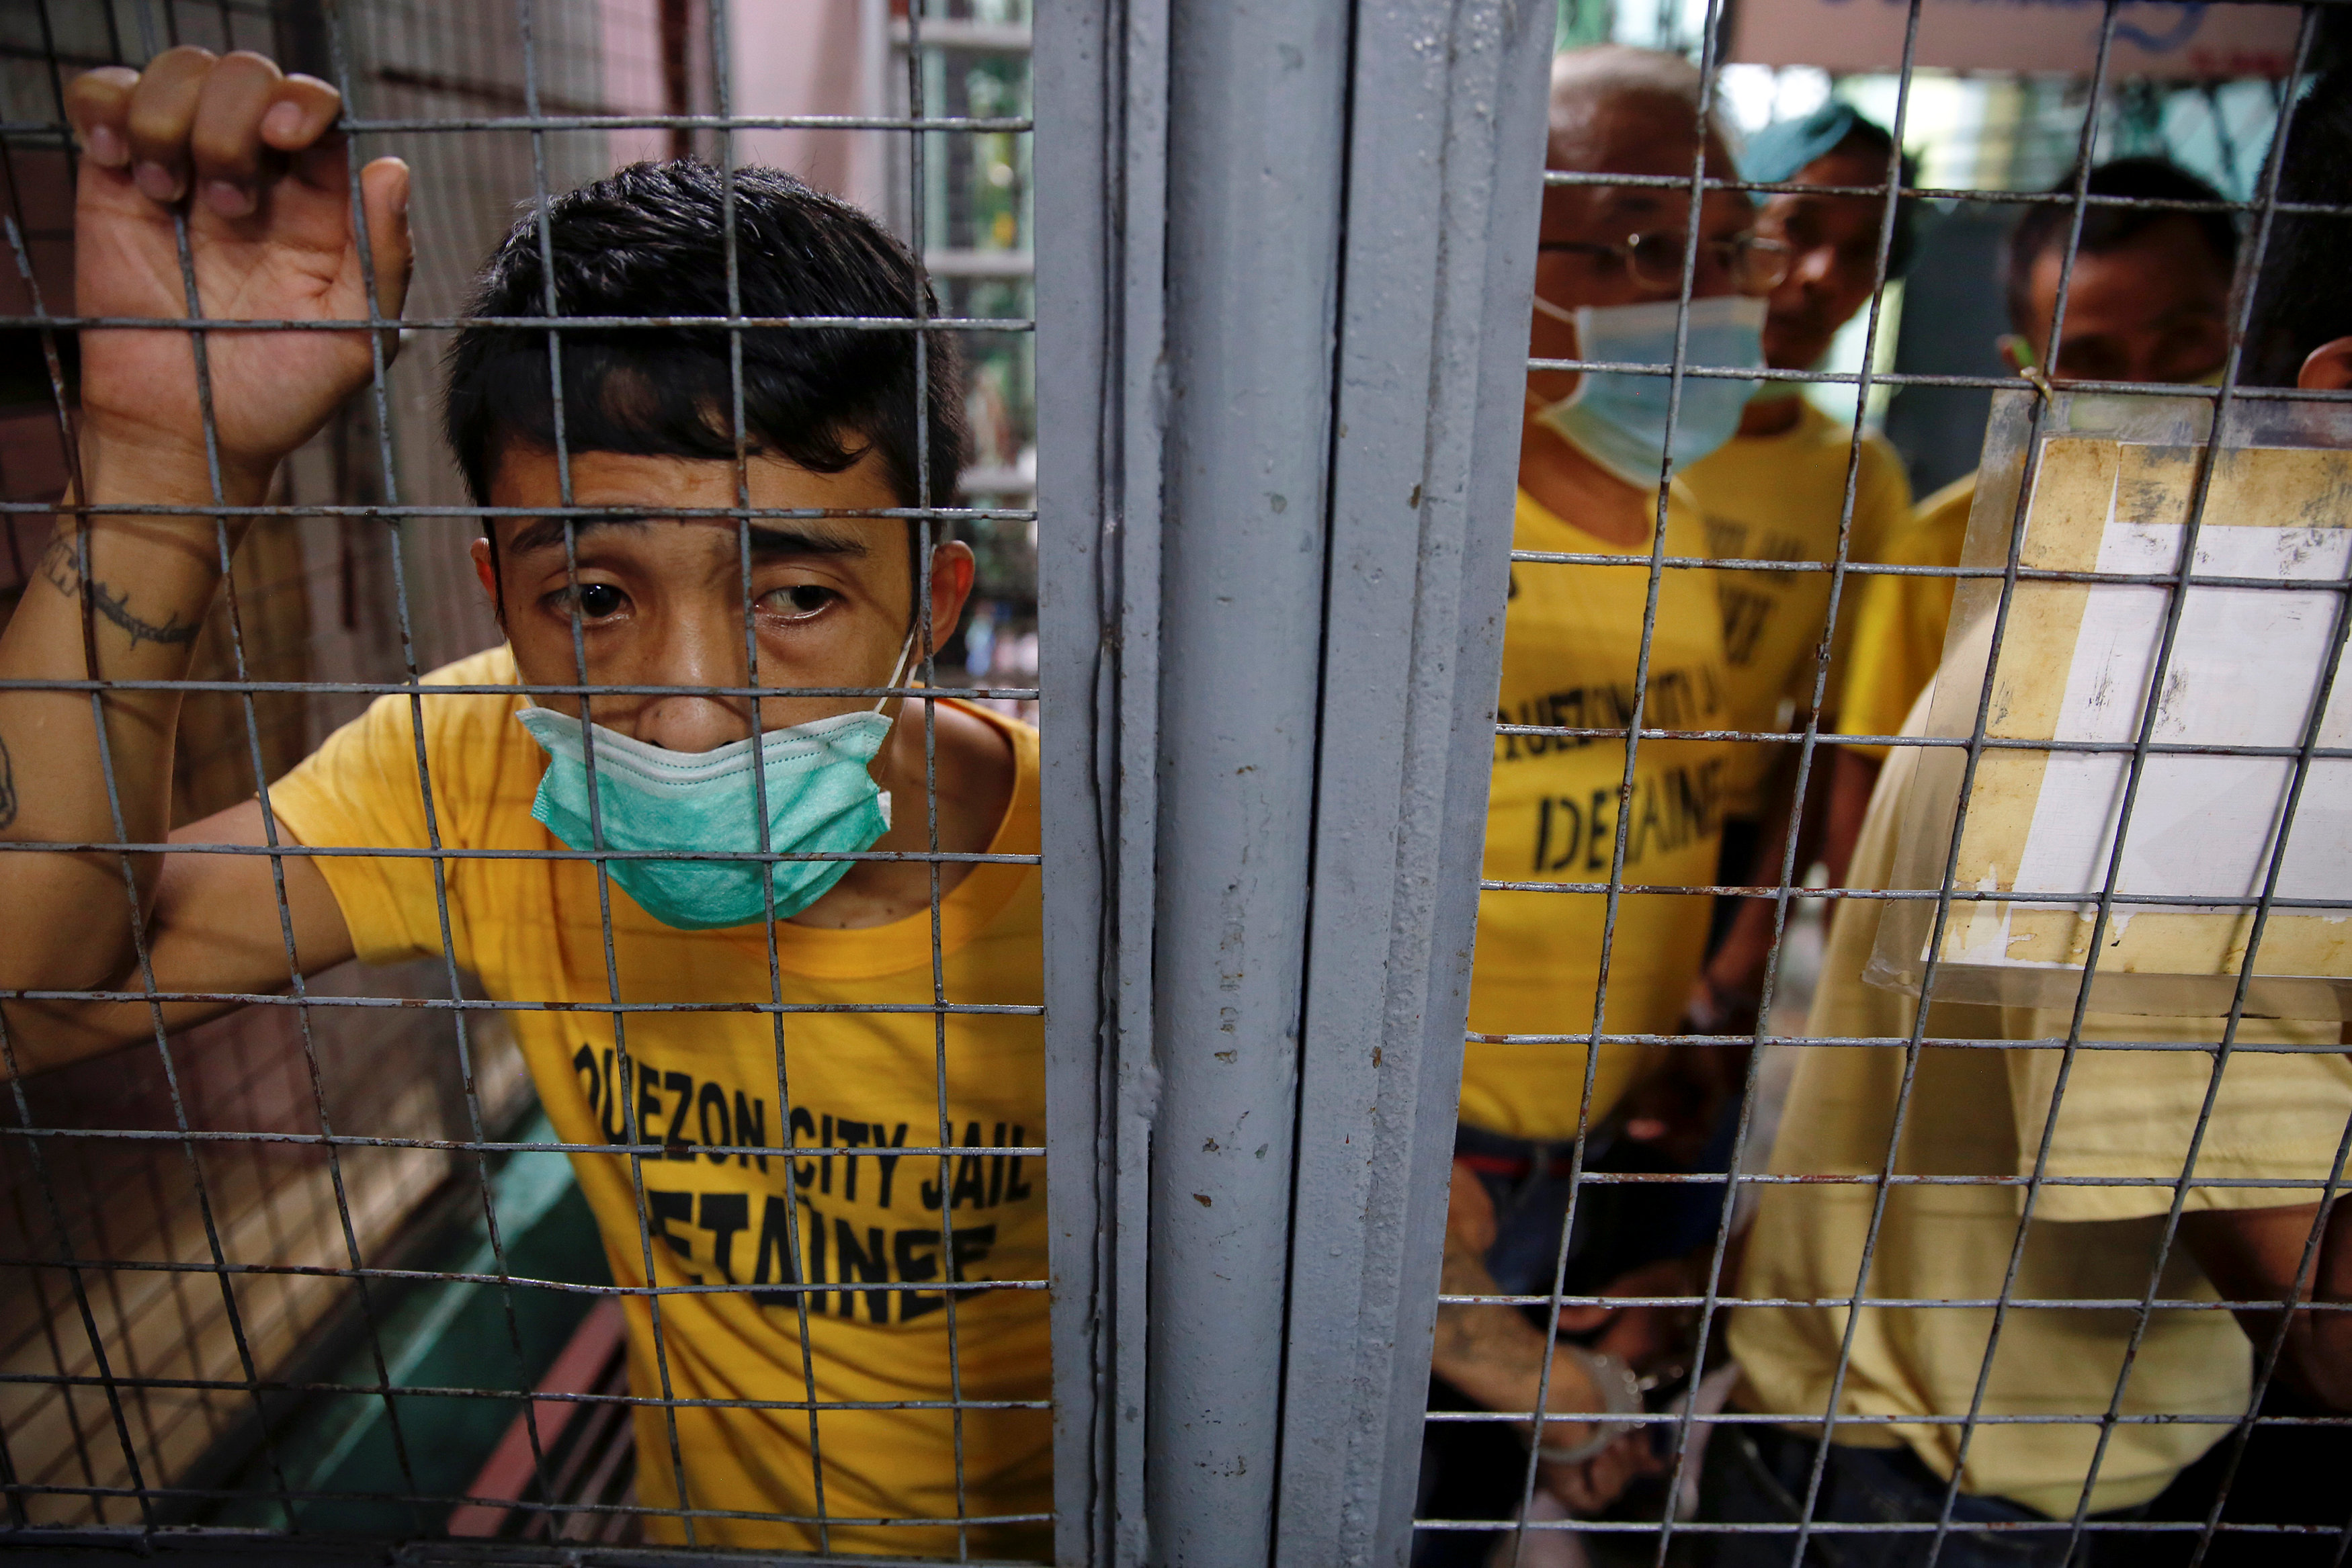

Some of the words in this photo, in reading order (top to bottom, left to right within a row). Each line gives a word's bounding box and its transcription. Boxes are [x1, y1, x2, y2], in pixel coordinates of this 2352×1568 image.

[789, 1106, 908, 1209] CITY
[921, 1120, 1032, 1210] JAIL
[647, 1189, 997, 1323] ETAINEE
